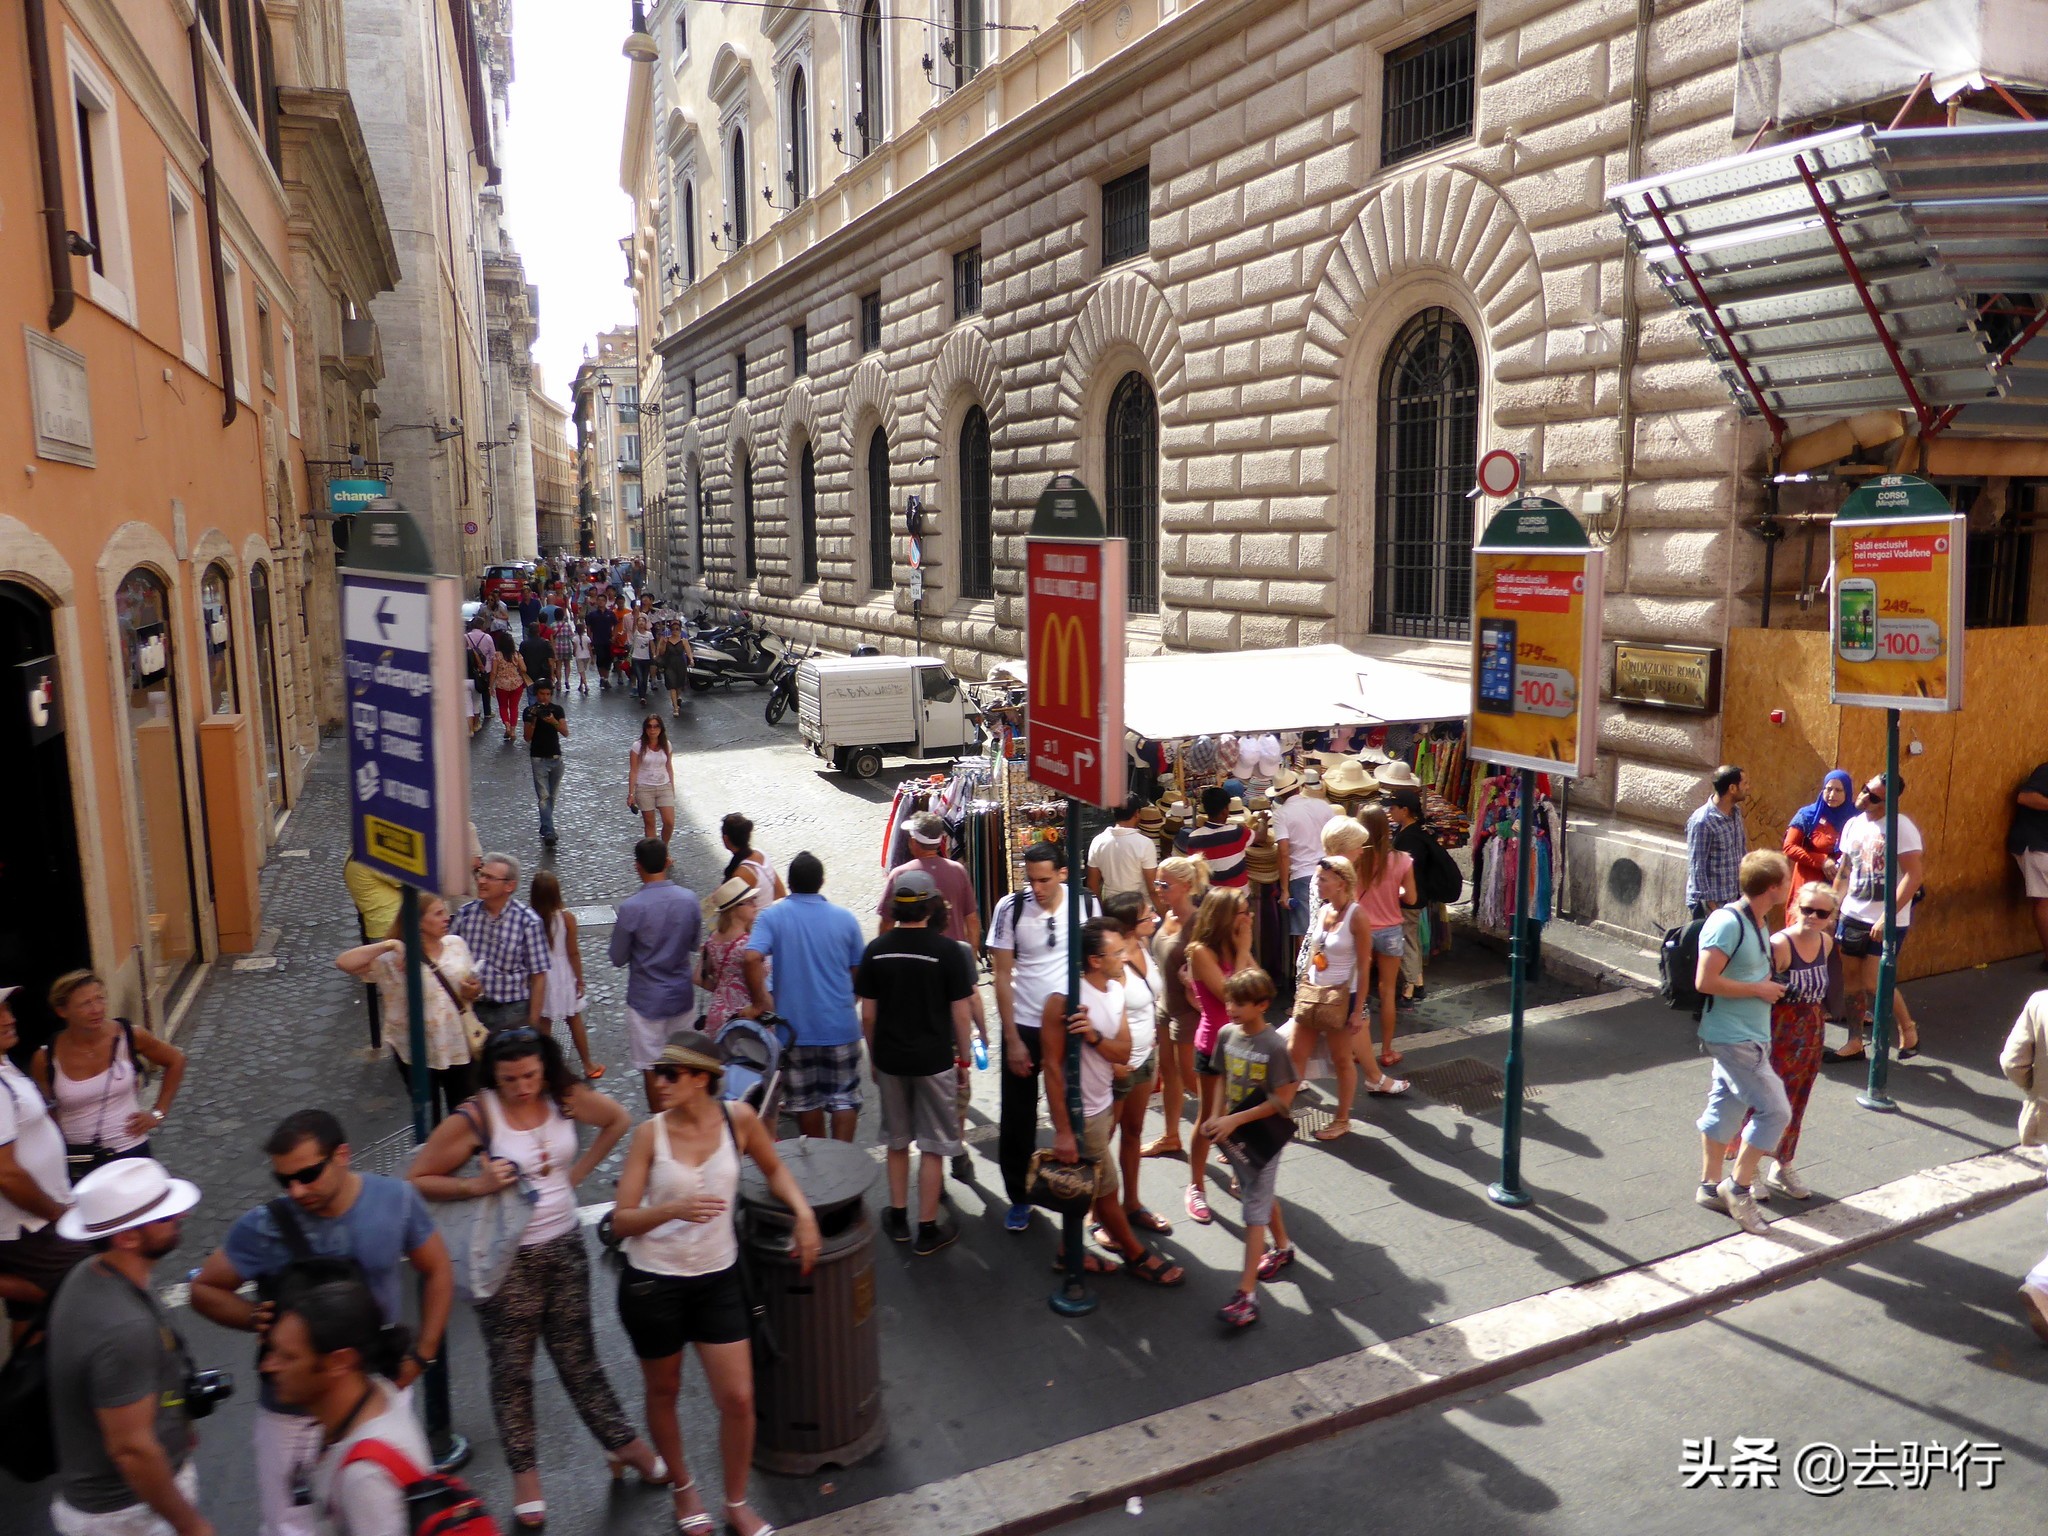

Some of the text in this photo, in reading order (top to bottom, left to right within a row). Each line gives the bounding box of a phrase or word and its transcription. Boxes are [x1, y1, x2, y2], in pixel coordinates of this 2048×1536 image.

[1878, 491, 1907, 500] CORSO
[1518, 516, 1547, 525] CORSO
[1854, 540, 1908, 551] Saldi esclusivi
[1854, 548, 1931, 561] nei negozi Vodafone
[1496, 573, 1549, 585] Saldi esclusivi
[1496, 584, 1570, 597] nei negozi Vodafone
[1878, 632, 1938, 655] -100 euro
[1621, 660, 1702, 680] FONDAZIONE ROMA
[1515, 680, 1555, 707] -100
[1632, 678, 1688, 696] MUSEO
[1036, 755, 1069, 777] minuto
